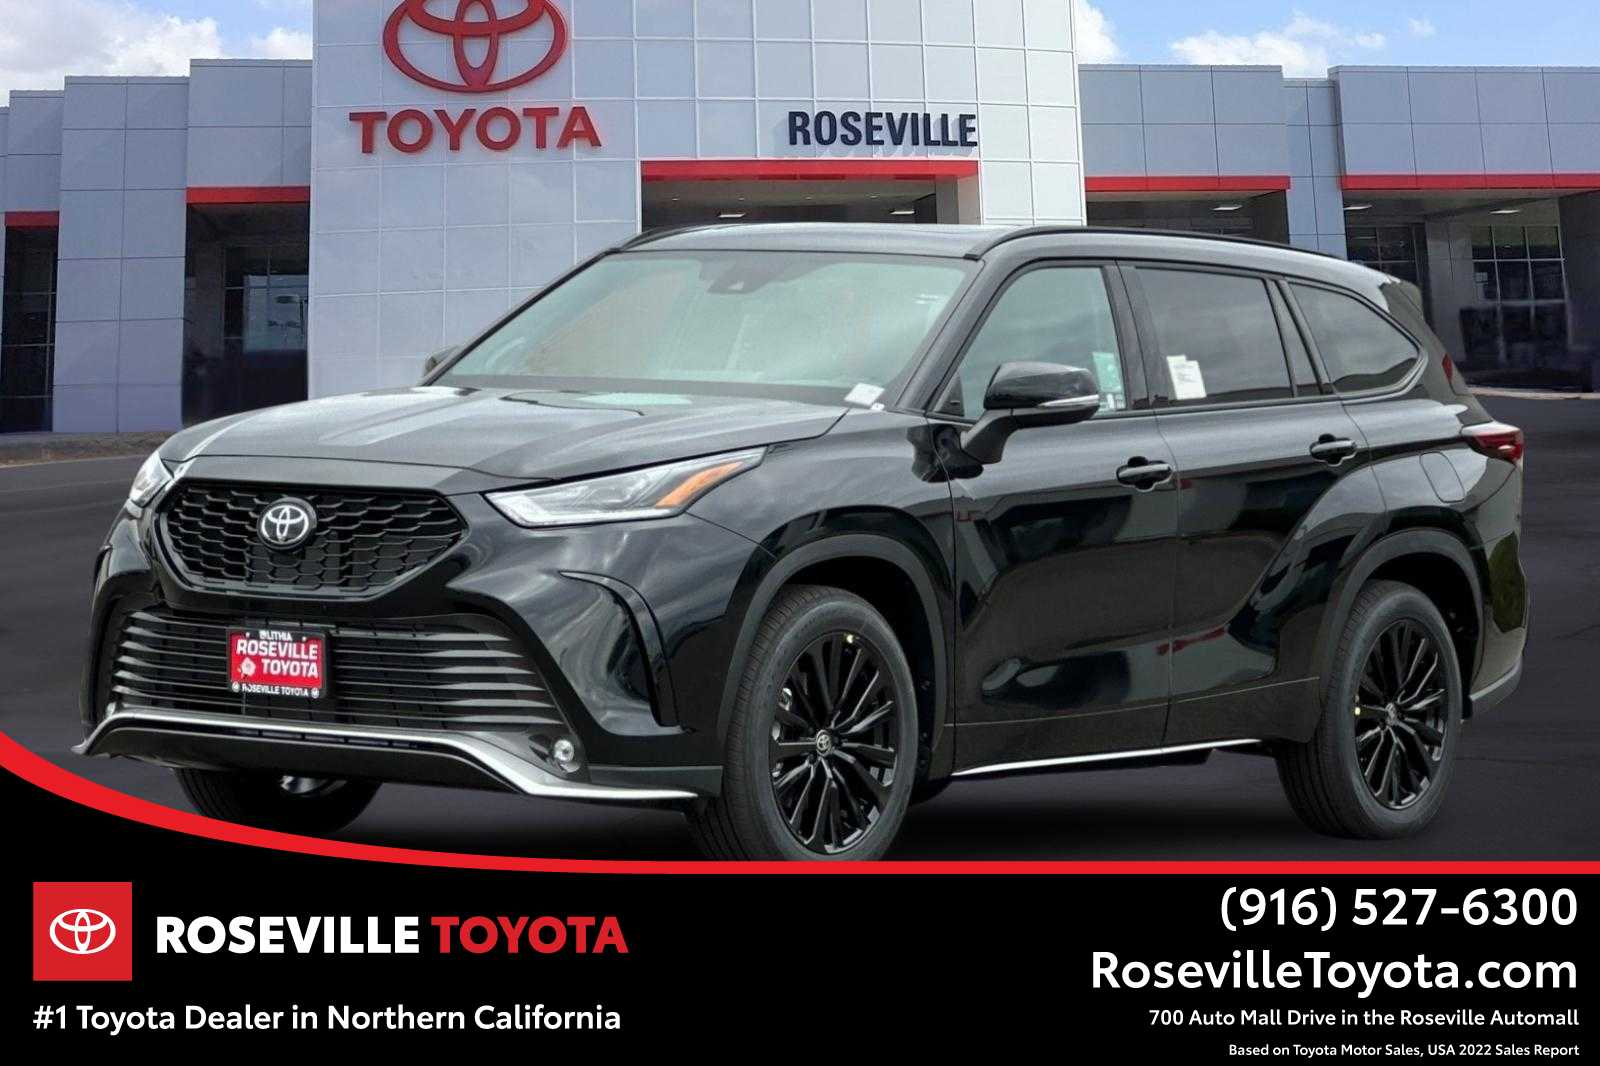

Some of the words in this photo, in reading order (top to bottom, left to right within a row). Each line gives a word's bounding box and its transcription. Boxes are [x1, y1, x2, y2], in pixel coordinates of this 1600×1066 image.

[349, 106, 603, 154] TOYOTA
[788, 111, 978, 148] ROSEVILLE
[236, 639, 318, 660] ROSEVILLE
[261, 658, 319, 679] TOYOTA
[241, 683, 280, 695] ROSEVILLE
[281, 686, 308, 697] TOYOTA
